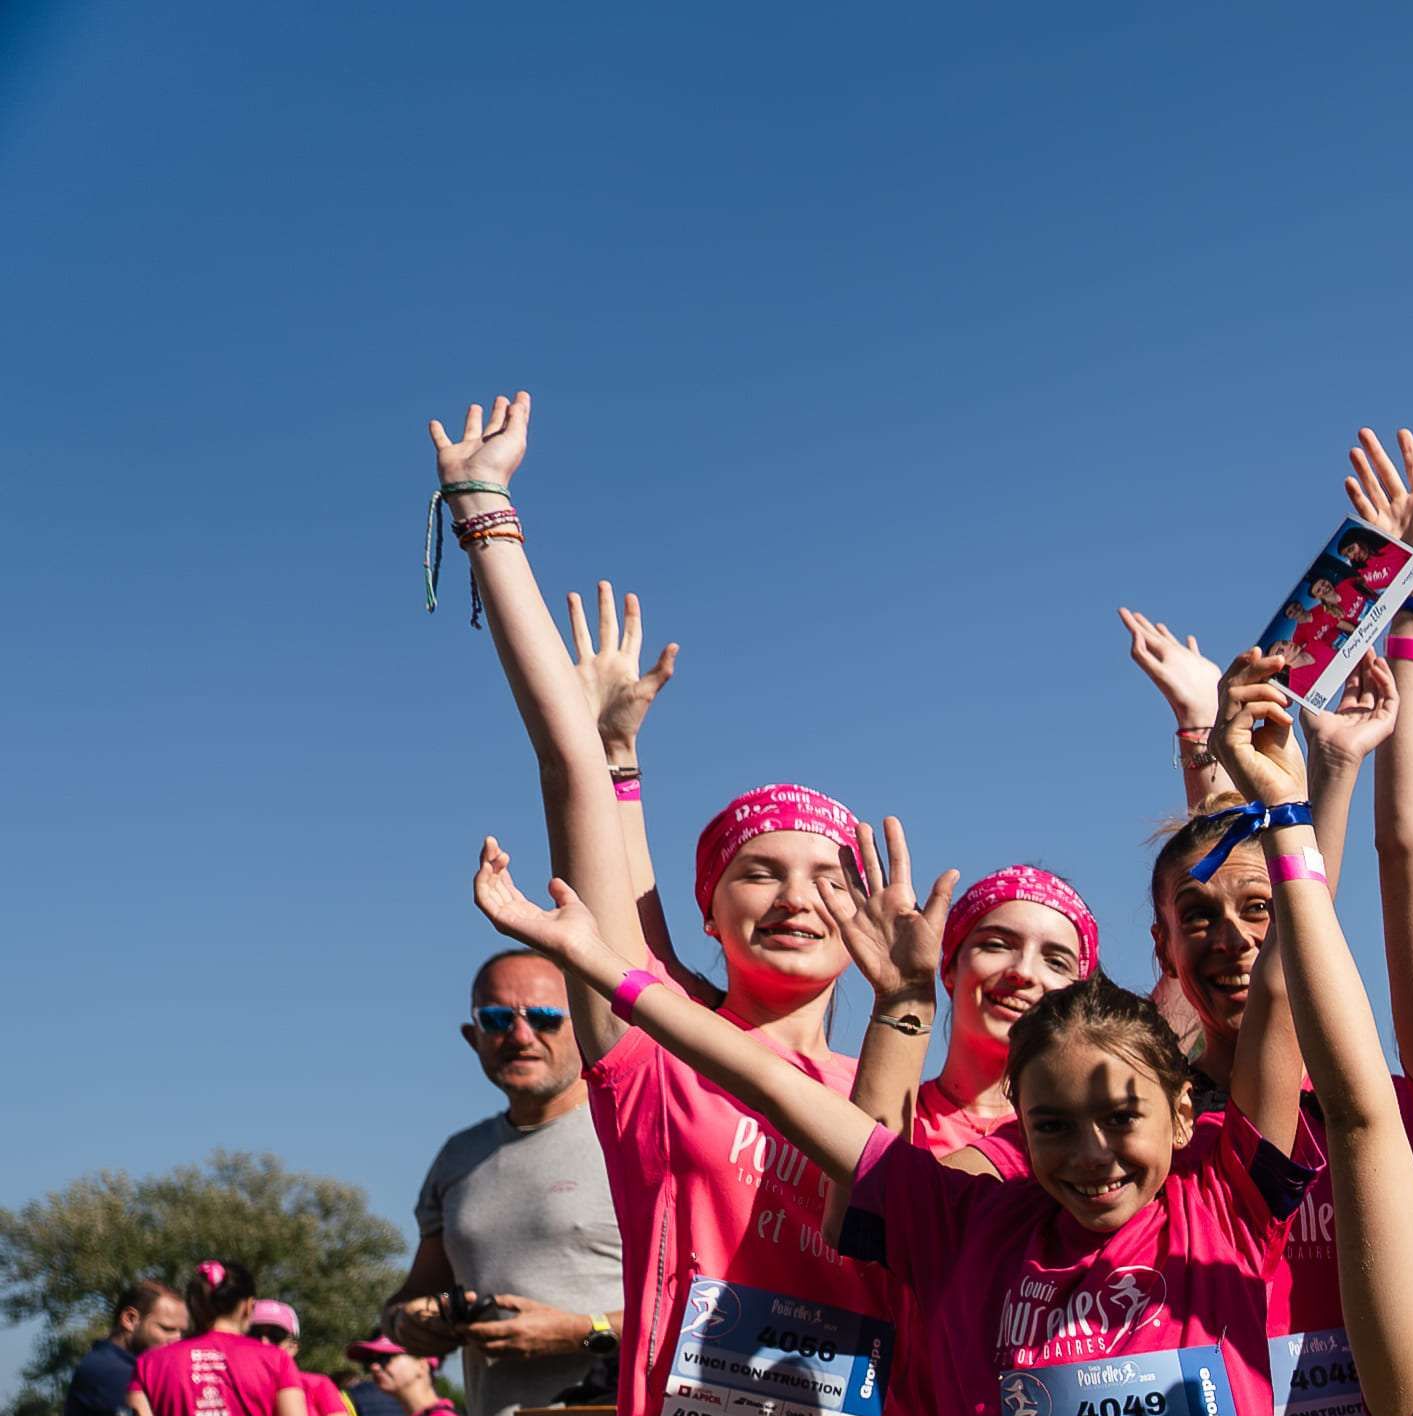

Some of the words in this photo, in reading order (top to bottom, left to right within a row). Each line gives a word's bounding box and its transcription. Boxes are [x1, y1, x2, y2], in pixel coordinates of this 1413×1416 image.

[757, 1208, 787, 1243] et
[1020, 1275, 1058, 1303] Courir
[756, 1325, 839, 1363] 4056
[683, 1351, 727, 1371] VINCI
[729, 1361, 844, 1398] CONSTRUCTION
[860, 1337, 881, 1400] Groupe
